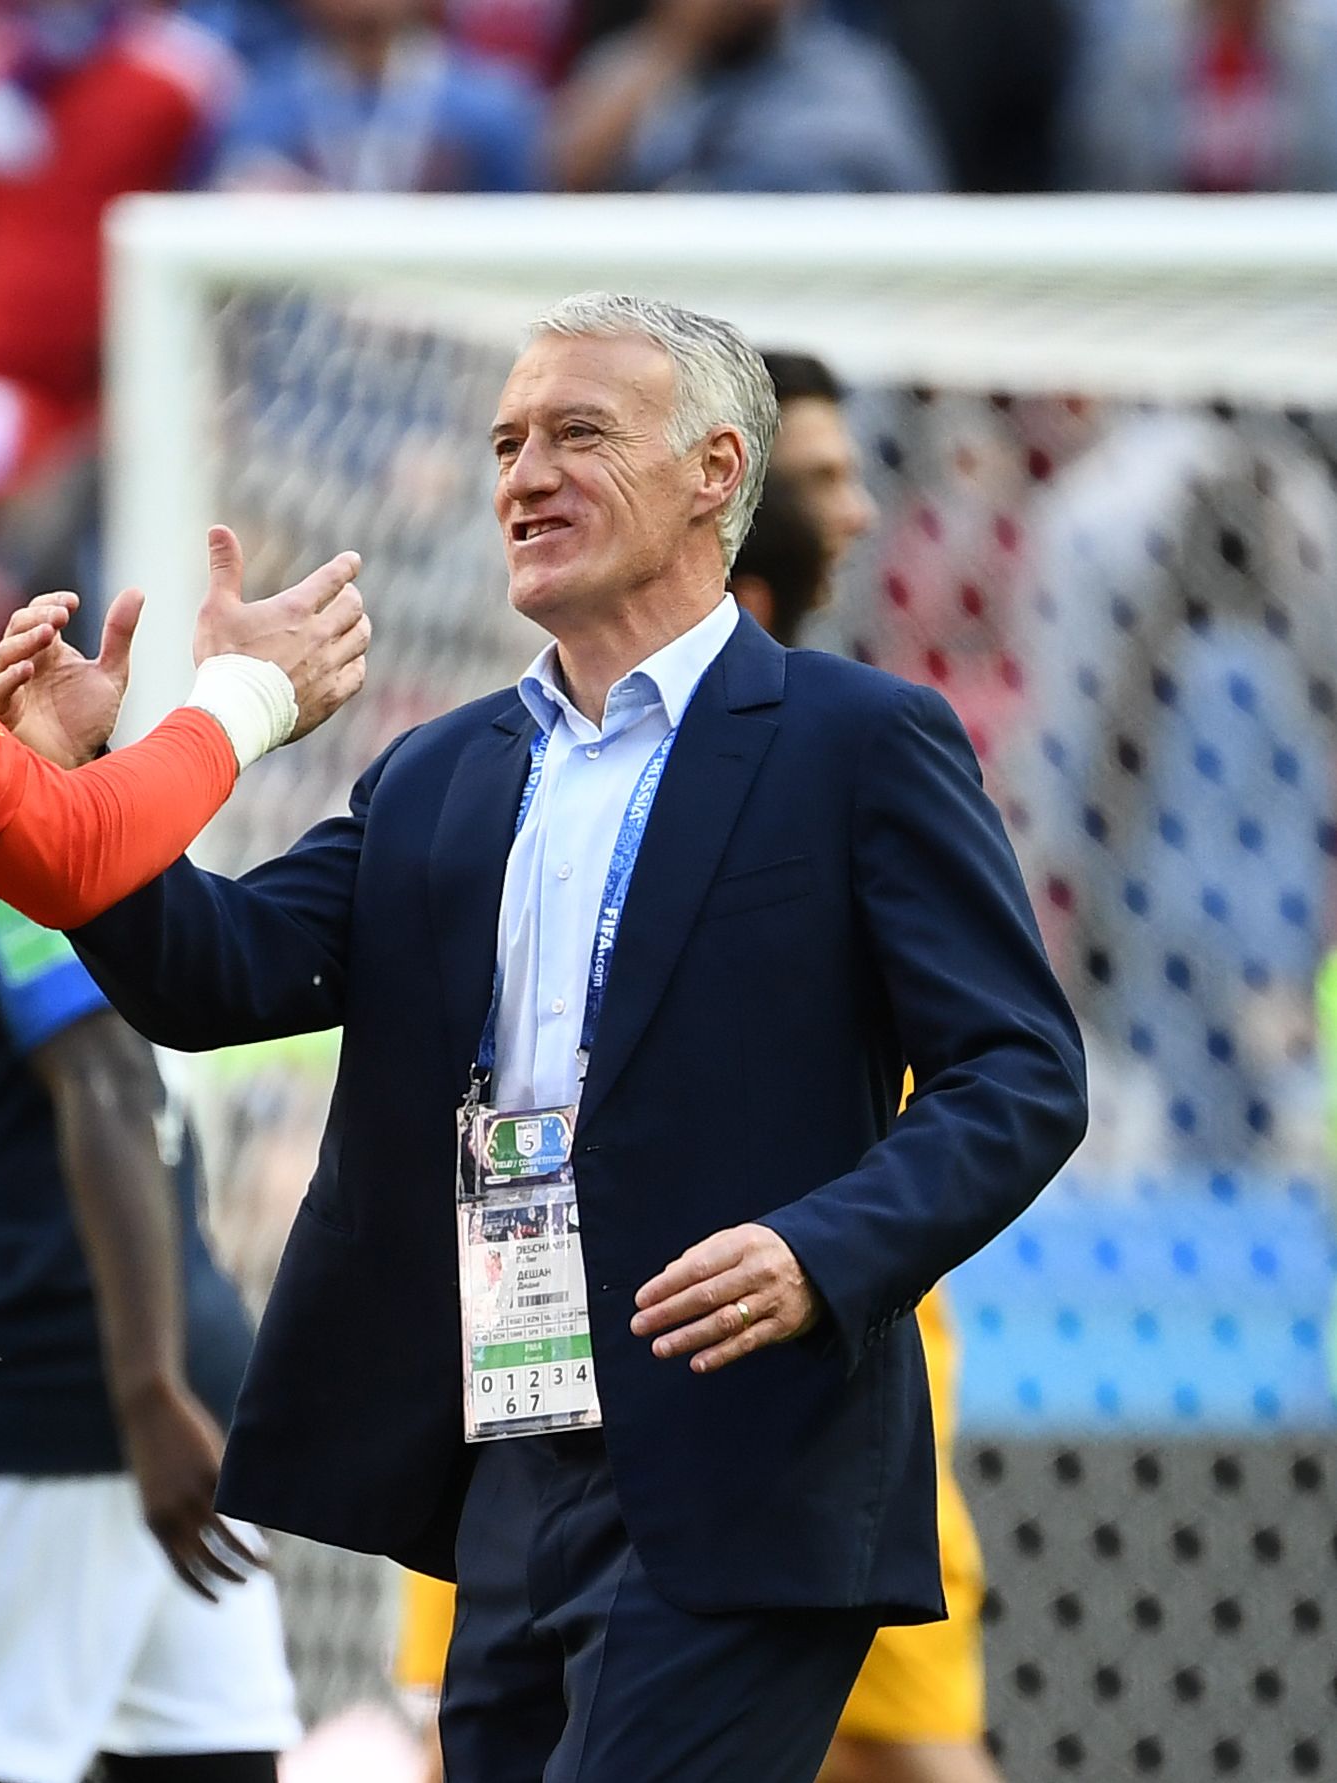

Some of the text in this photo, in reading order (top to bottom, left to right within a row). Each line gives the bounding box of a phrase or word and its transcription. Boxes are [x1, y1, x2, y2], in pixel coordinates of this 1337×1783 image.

[629, 757, 664, 820] RUSSIA
[593, 907, 619, 987] FIFA.com
[524, 1134, 534, 1151] 5
[494, 1159, 513, 1169] FIELD
[520, 1165, 539, 1174] AREA
[517, 1267, 551, 1281] ДЕШАН
[481, 1364, 587, 1393] 0 1 2 3 4
[506, 1394, 540, 1414] 6 7
